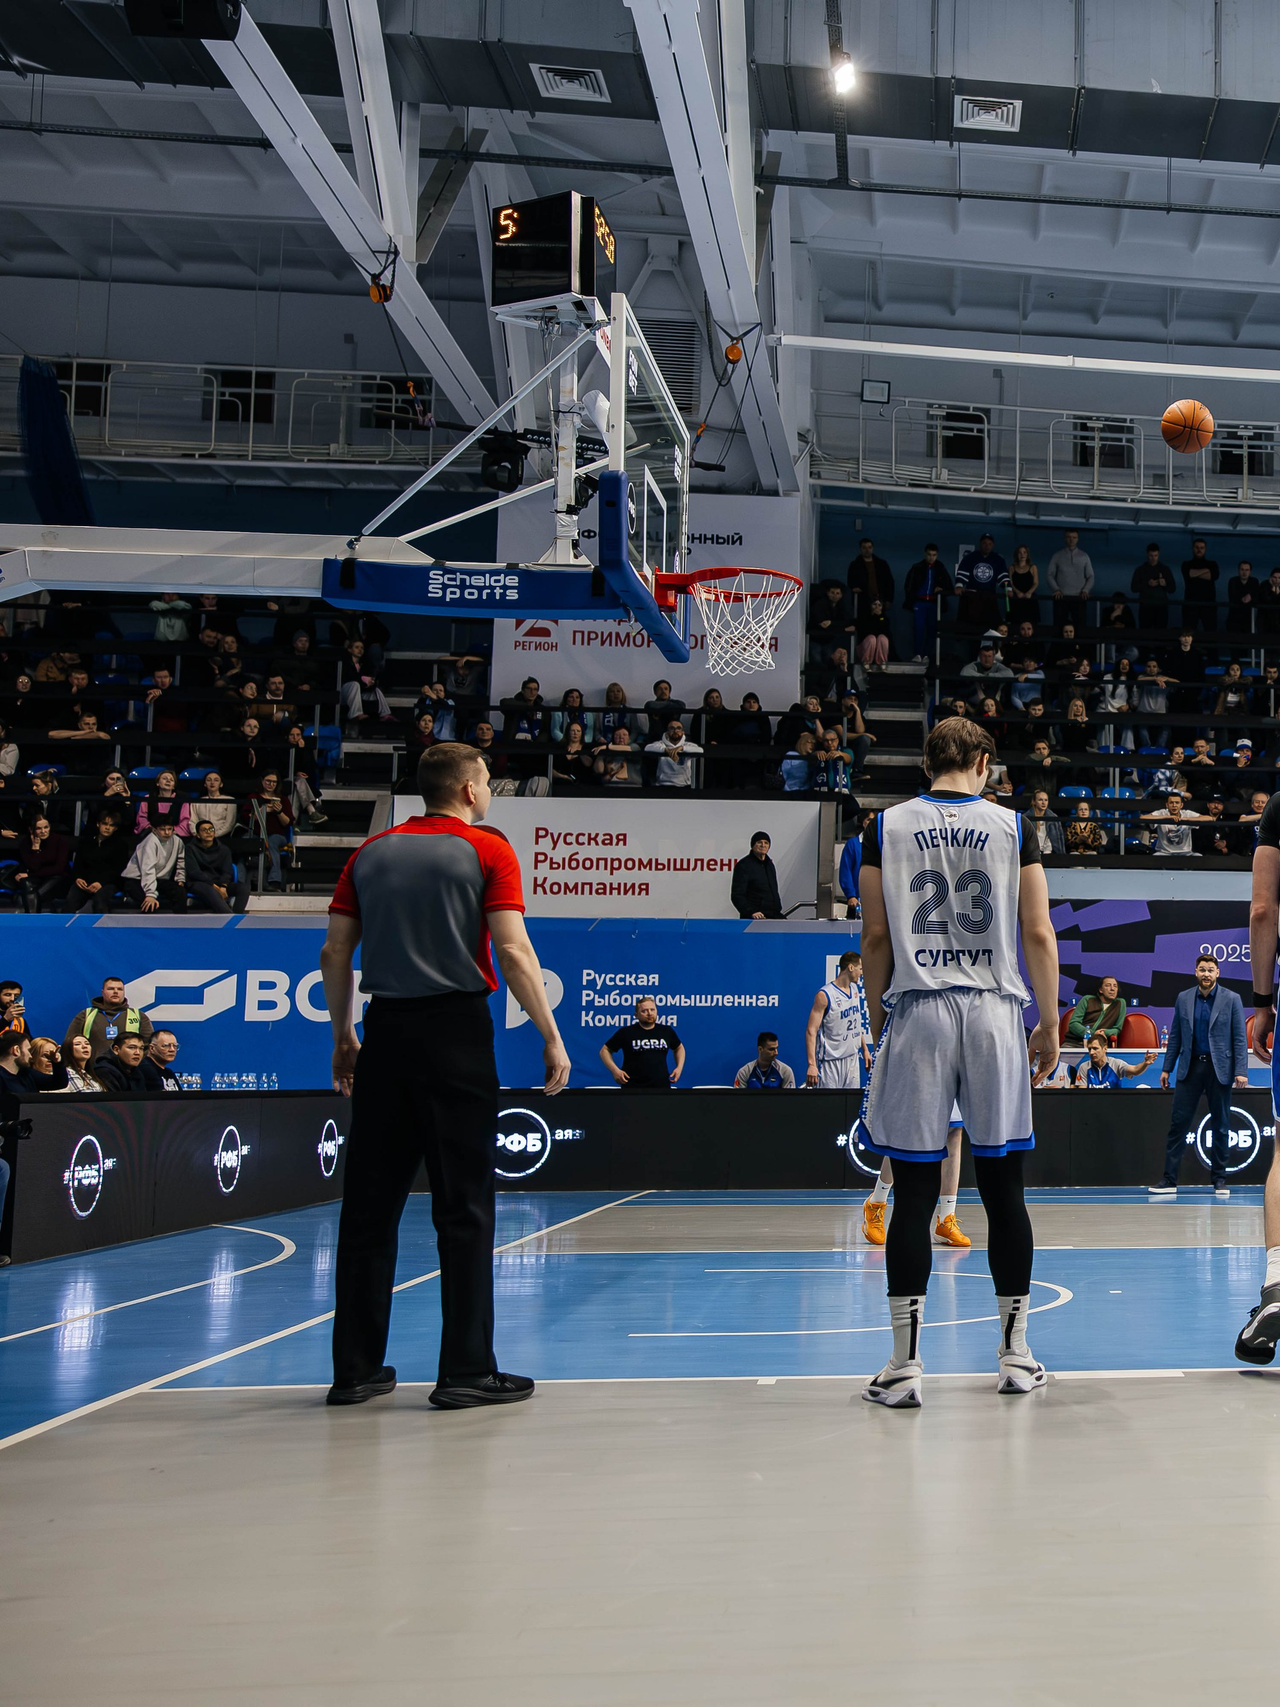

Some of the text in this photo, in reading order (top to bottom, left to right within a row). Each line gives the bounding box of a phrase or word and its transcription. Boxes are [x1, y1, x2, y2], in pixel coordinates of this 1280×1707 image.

[428, 570, 519, 587] Schelde
[427, 584, 519, 601] Sports
[514, 640, 558, 652] РЕГИОН
[534, 827, 628, 850] Русская
[913, 827, 990, 852] ПЕЧКИН
[533, 851, 739, 875] Рыбопромышлен
[532, 876, 650, 896] Компания
[909, 869, 994, 935] 23
[914, 949, 993, 967] СУРГУТ
[582, 969, 659, 989] Русская
[632, 1039, 668, 1049] UGRA
